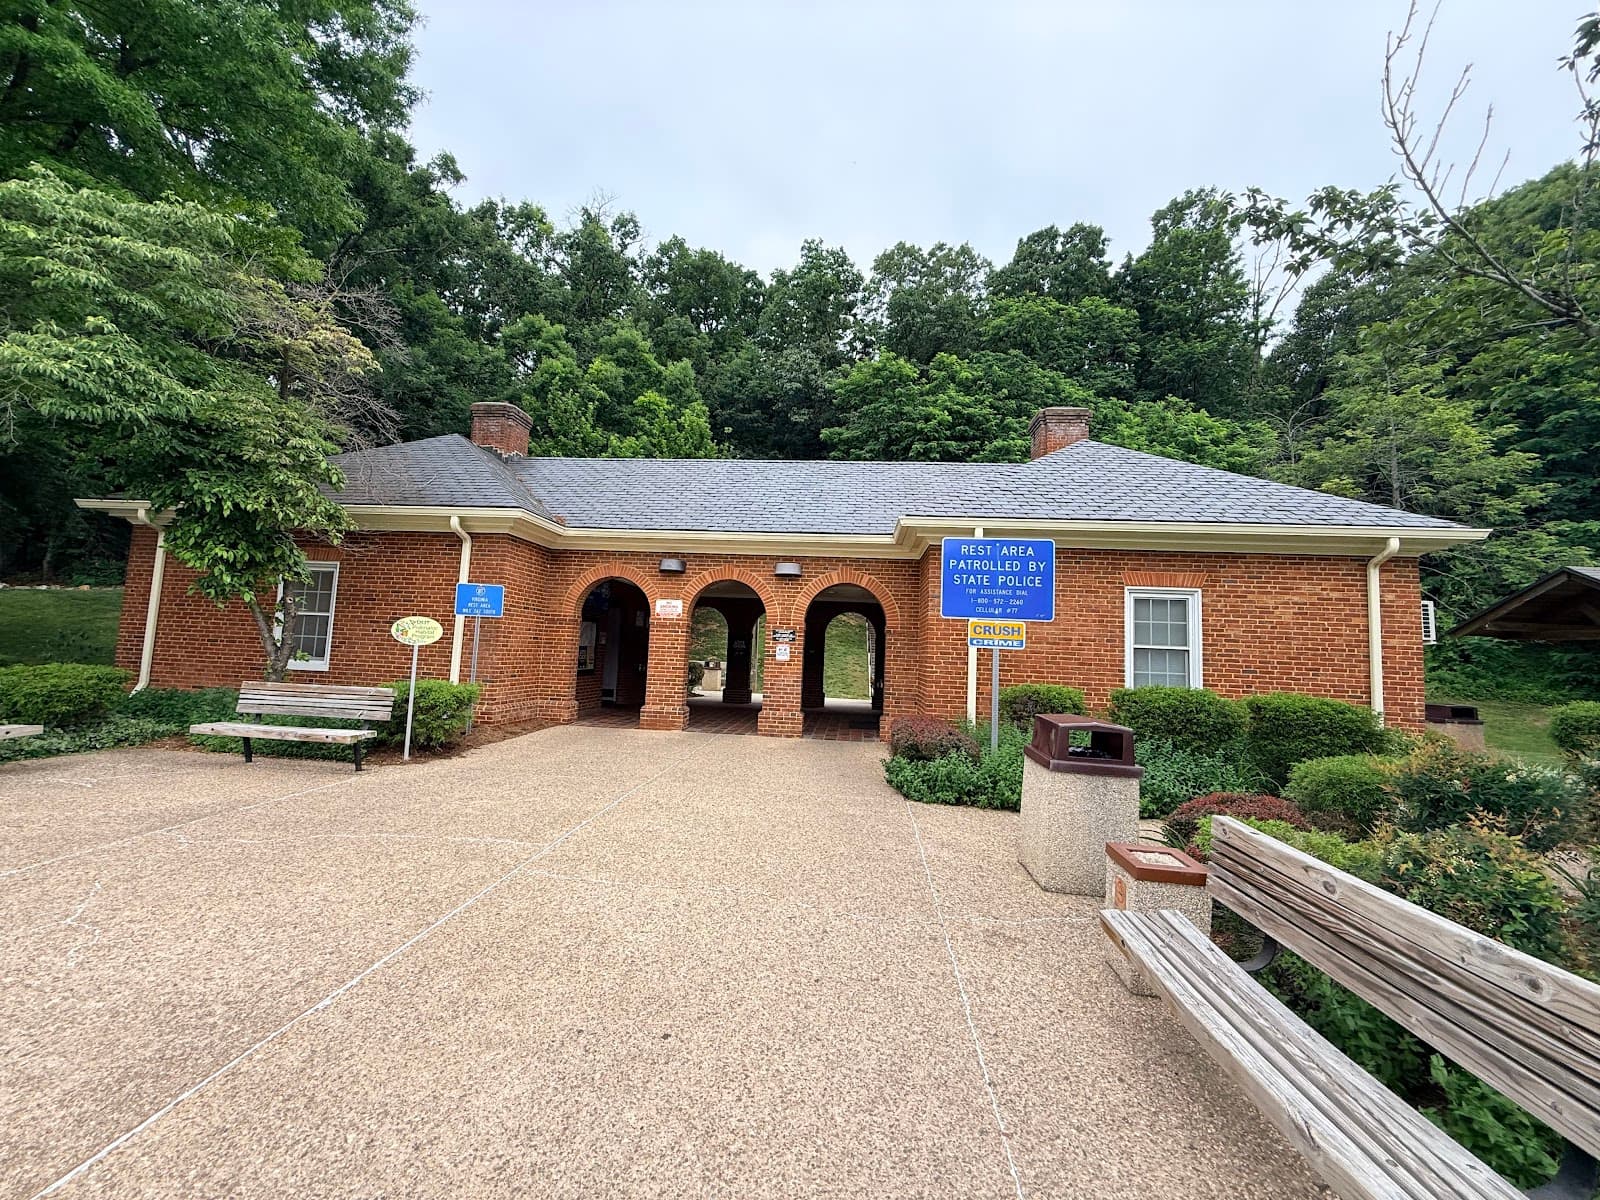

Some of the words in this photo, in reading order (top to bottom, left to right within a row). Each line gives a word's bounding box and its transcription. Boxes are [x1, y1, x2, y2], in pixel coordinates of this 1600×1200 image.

[961, 545, 992, 555] REST
[1001, 546, 1035, 556] AREA
[949, 560, 1020, 571] PATROLLED
[1029, 561, 1046, 572] BY
[953, 575, 990, 586] STATE
[998, 575, 1042, 587] POLICE
[973, 625, 1020, 636] CRUSH
[972, 639, 1022, 647] CRIME
